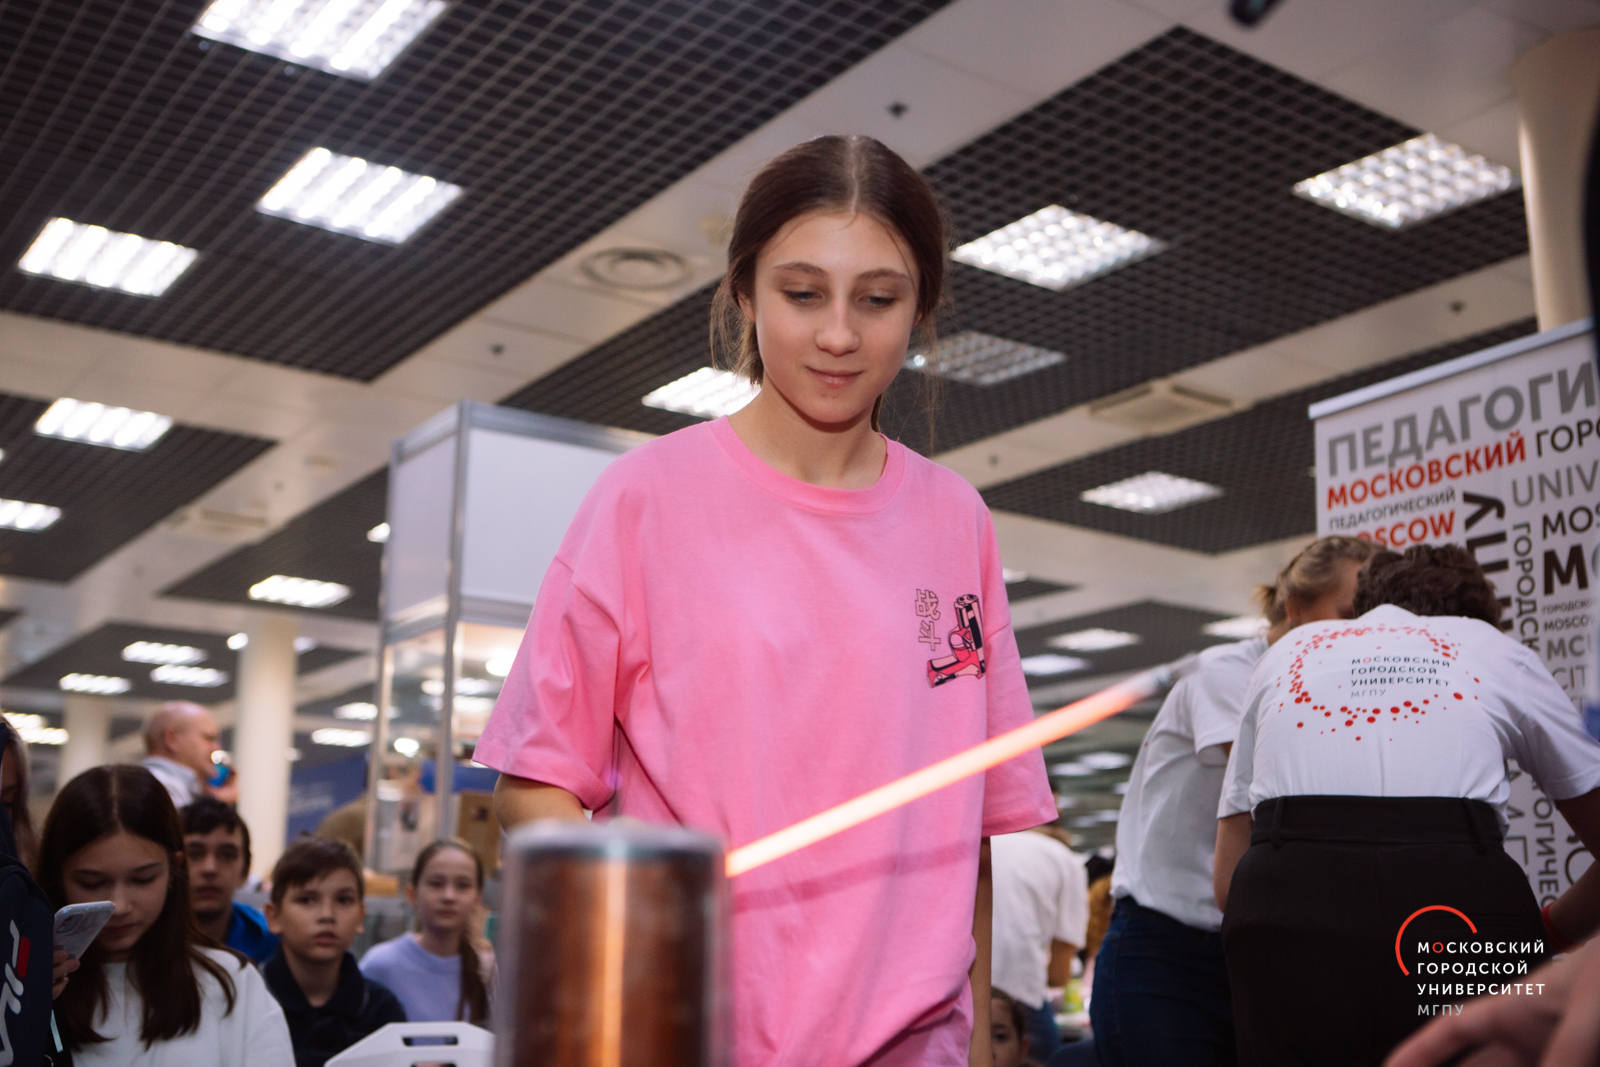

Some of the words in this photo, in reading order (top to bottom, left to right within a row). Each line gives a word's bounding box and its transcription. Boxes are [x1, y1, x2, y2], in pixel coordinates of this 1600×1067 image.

[1328, 361, 1597, 478] ПЕДАГОГИ
[1536, 417, 1600, 458] ГОР
[1327, 429, 1526, 510] МОСКОВСКИЙ
[1512, 459, 1600, 508] UNIV
[1329, 486, 1456, 531] ПЕДАГОГИЧЕСКИЙ
[1544, 613, 1595, 632] MOSCO
[1351, 655, 1450, 668] МОСКОВСКИЙ
[1351, 665, 1437, 676] ГОРОДСКОЙ
[1350, 688, 1387, 699] МГПУ
[1351, 676, 1450, 688] УНИВЕРСИТЕТ
